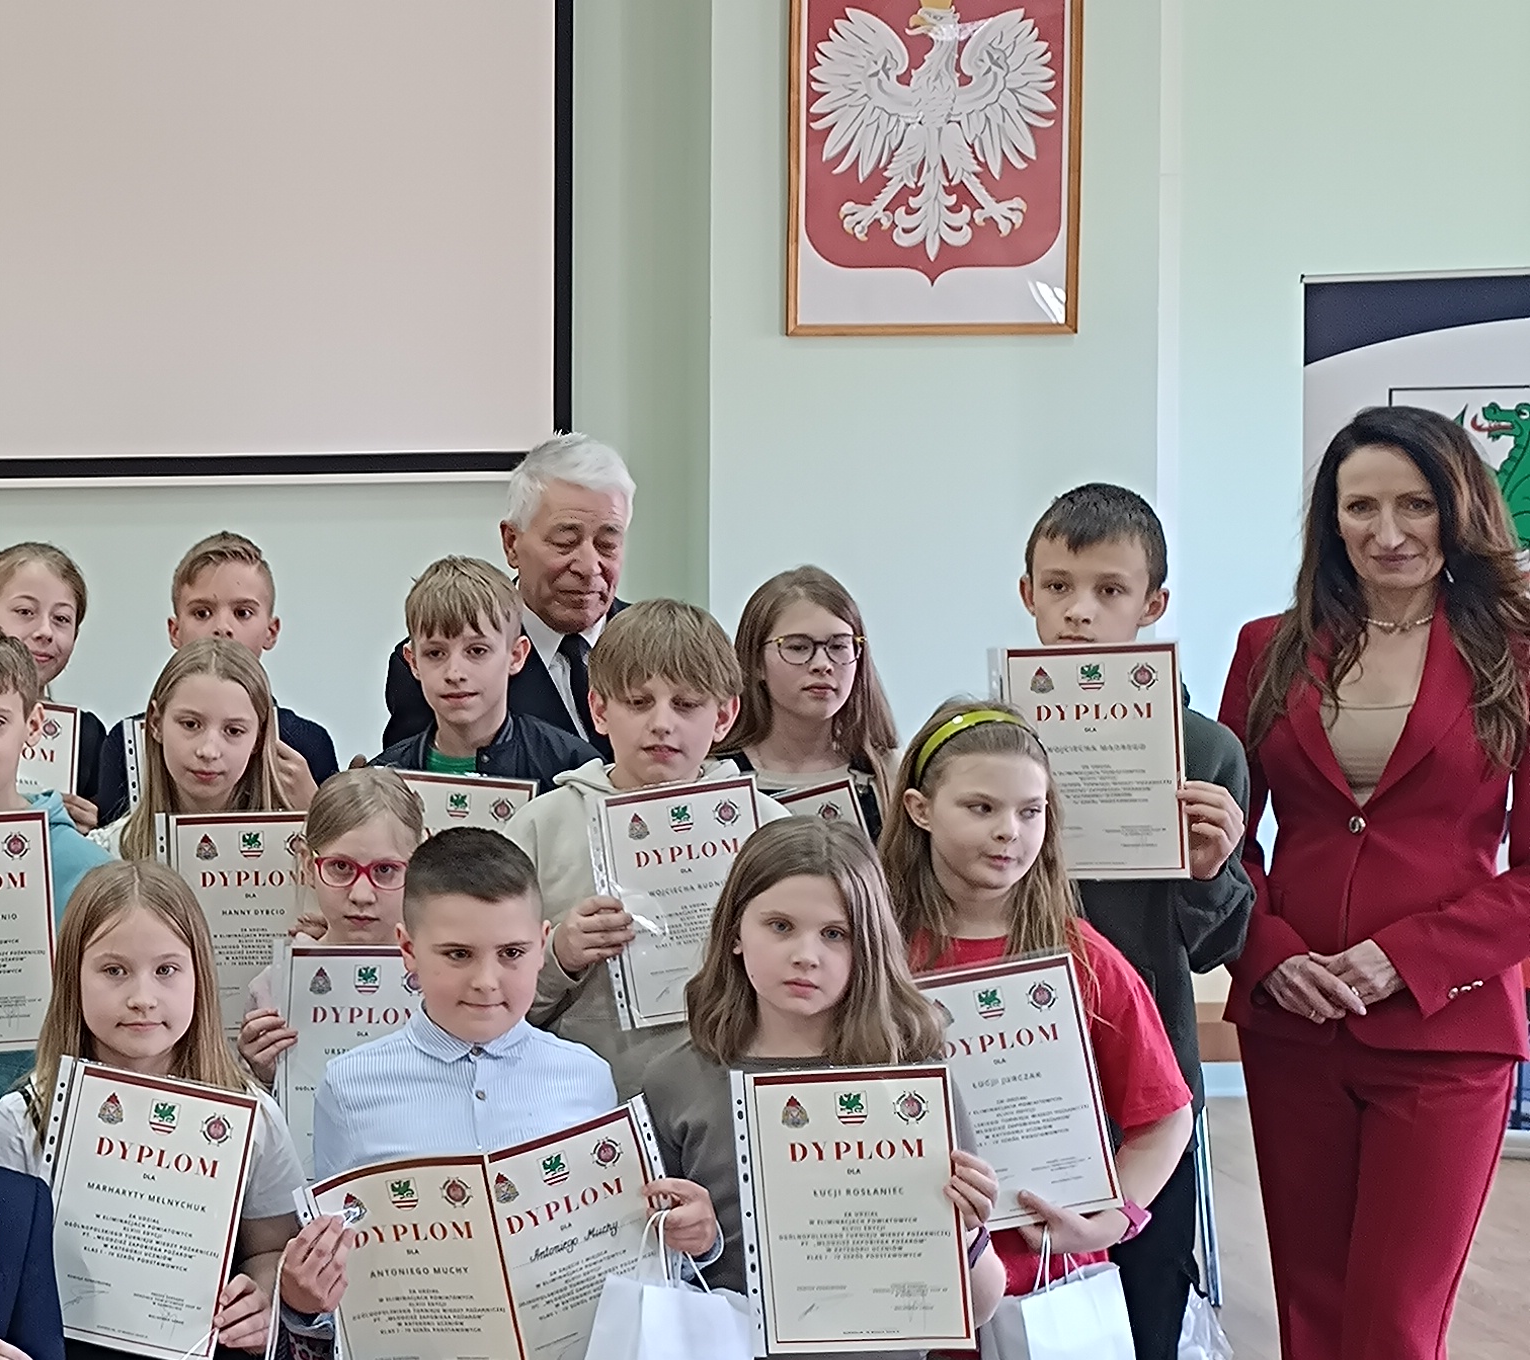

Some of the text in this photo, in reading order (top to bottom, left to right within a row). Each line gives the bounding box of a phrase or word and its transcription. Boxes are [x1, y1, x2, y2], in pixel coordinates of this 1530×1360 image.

[1036, 702, 1152, 721] DYPLOM
[635, 838, 739, 868] DYPLOM
[942, 1023, 1059, 1058] DYPLOM
[95, 1136, 219, 1179] DYPLOM
[789, 1137, 925, 1163] DYPLOM
[87, 1182, 145, 1199] MARHARYTY
[142, 1173, 156, 1181] DLA
[506, 1177, 623, 1235] DYPLOM
[355, 1221, 473, 1249] DYPLOM
[370, 1266, 469, 1278] ANTONIEGO MUCHY
